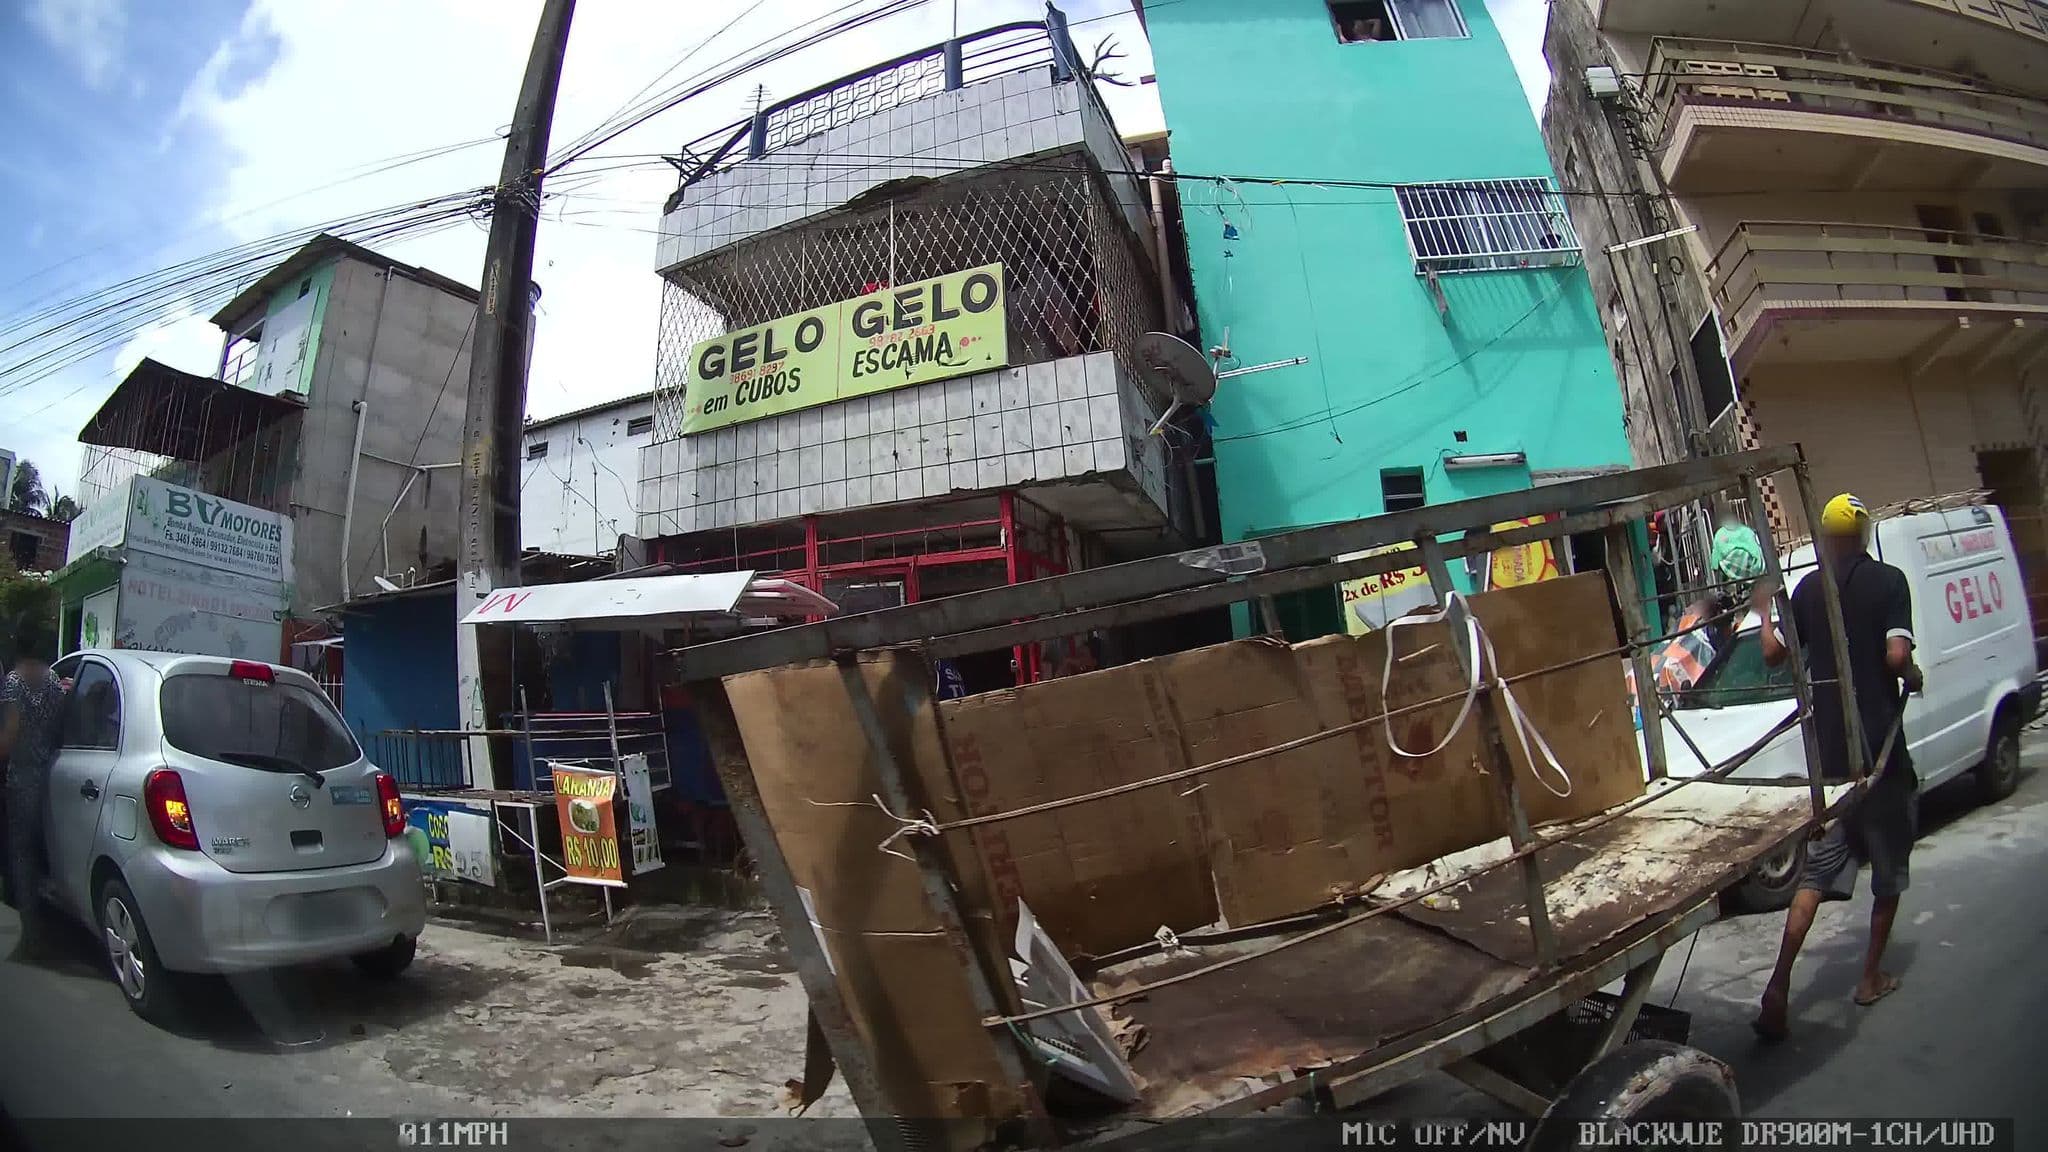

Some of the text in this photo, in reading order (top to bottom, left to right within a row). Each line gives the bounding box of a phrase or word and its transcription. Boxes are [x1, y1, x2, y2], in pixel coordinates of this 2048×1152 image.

[852, 272, 998, 339] GELO
[698, 317, 825, 380] GELO
[852, 331, 953, 378] ESCAMA
[703, 367, 801, 415] em CUBOS
[220, 512, 282, 542] MOTORES
[1343, 589, 1359, 602] 2x
[1361, 582, 1379, 596] de
[1379, 569, 1406, 589] R$
[1945, 570, 2003, 624] GELO
[556, 774, 612, 797] LARANJA
[566, 835, 582, 869] R$
[584, 837, 618, 875] 10,00
